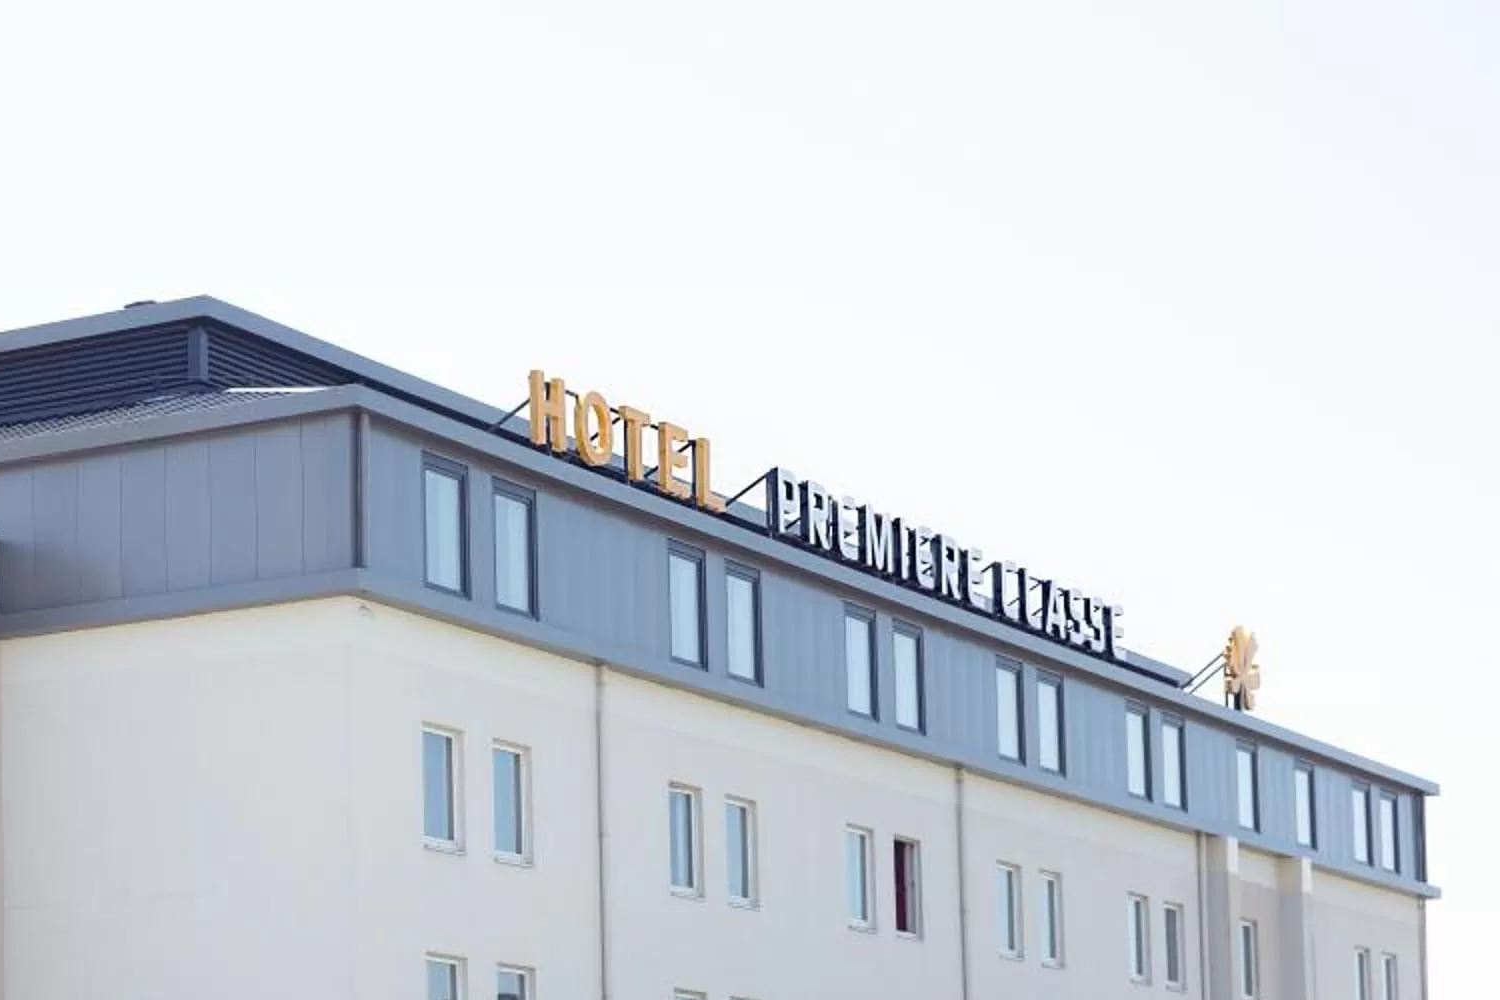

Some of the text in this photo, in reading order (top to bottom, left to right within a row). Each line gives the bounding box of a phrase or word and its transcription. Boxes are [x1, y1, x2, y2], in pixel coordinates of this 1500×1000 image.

[528, 369, 727, 513] HOTEL
[766, 466, 1126, 662] PREMIERE CLASSE
